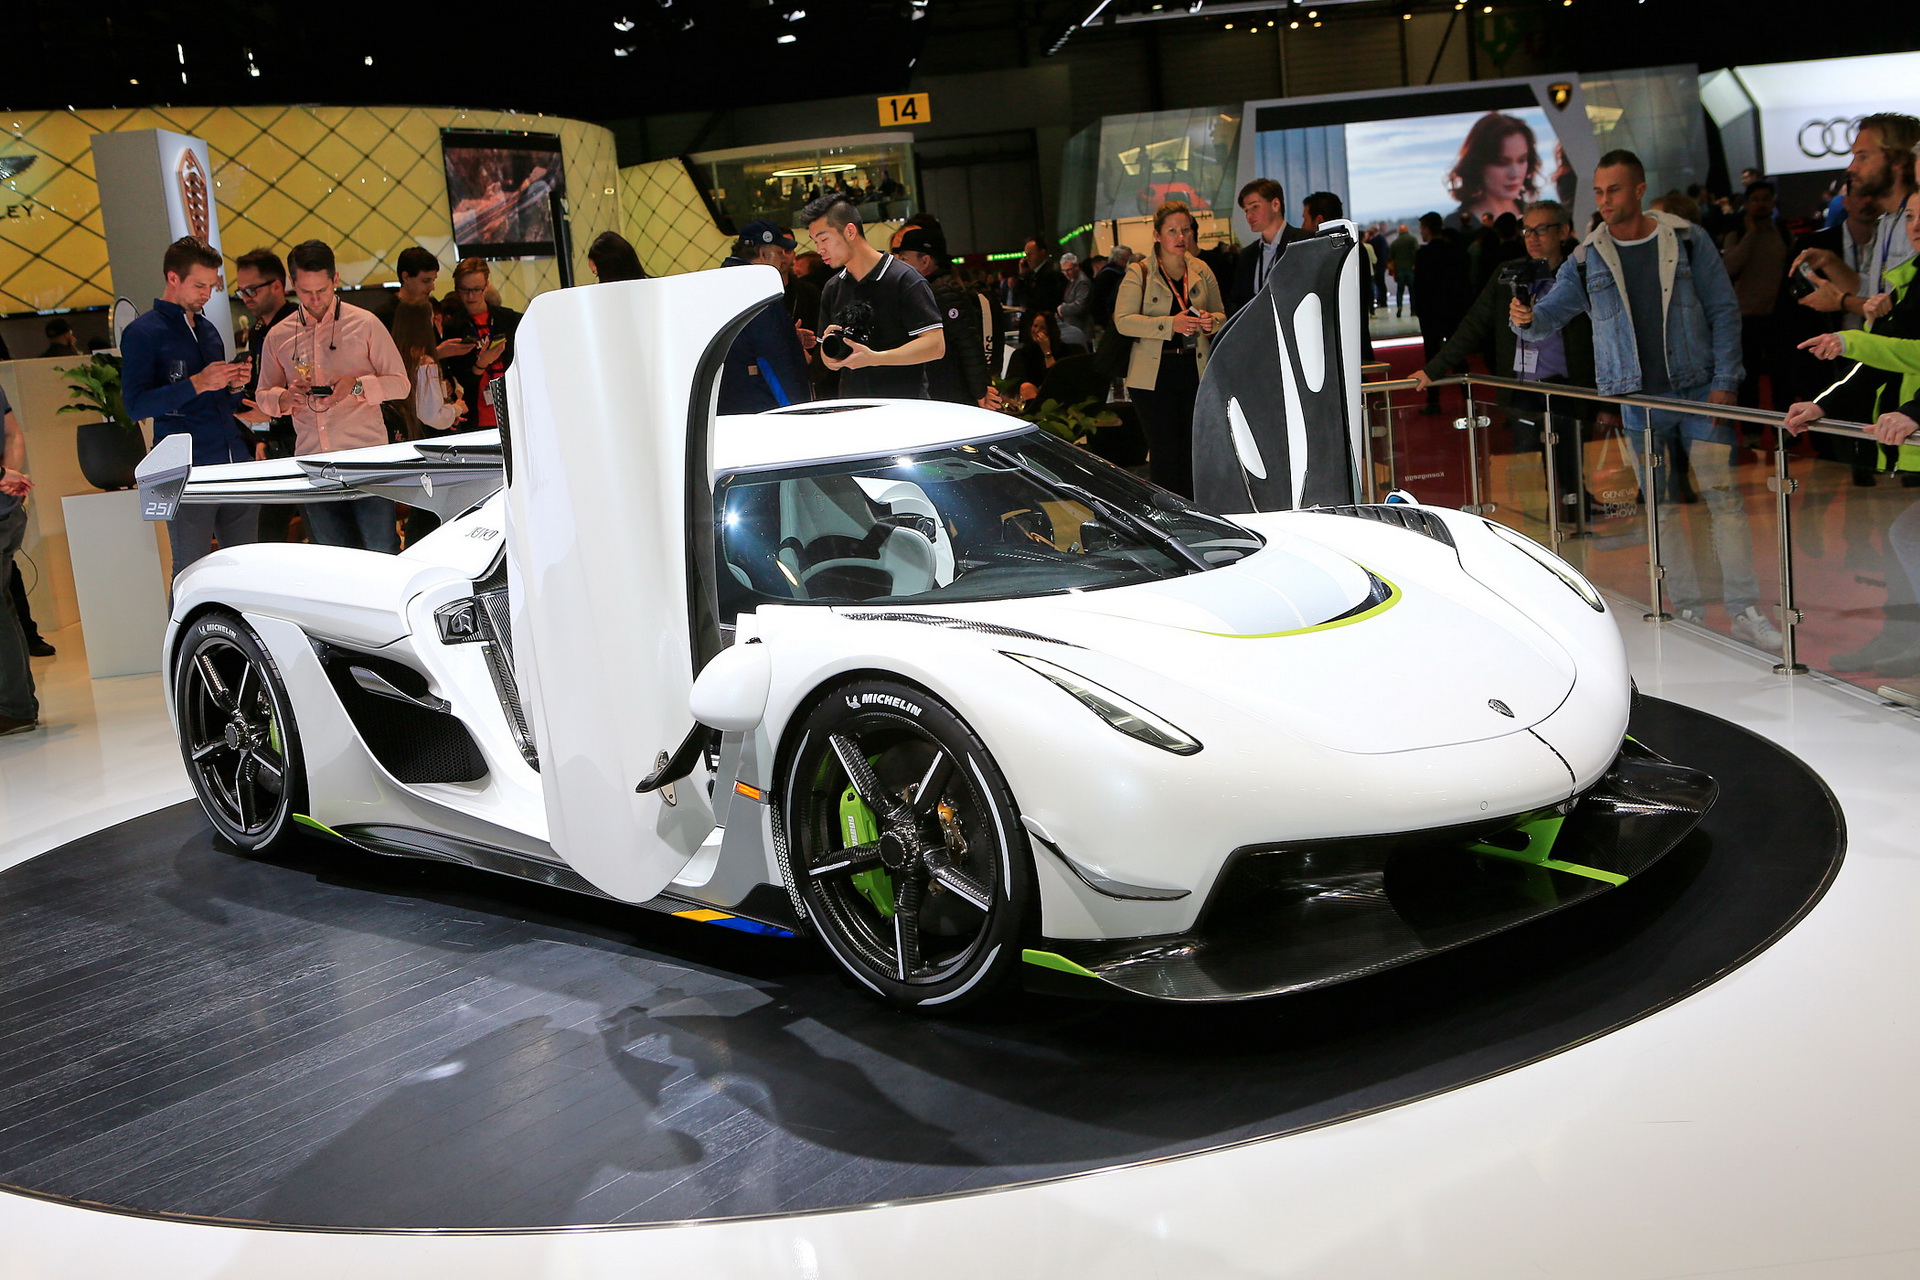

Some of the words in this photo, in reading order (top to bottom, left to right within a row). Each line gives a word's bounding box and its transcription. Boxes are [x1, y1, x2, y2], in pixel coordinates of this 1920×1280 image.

[890, 97, 918, 122] 14
[0, 203, 34, 219] EY
[145, 502, 173, 516] 251
[1604, 507, 1638, 520] SHOW
[861, 693, 923, 717] MICHELIN
